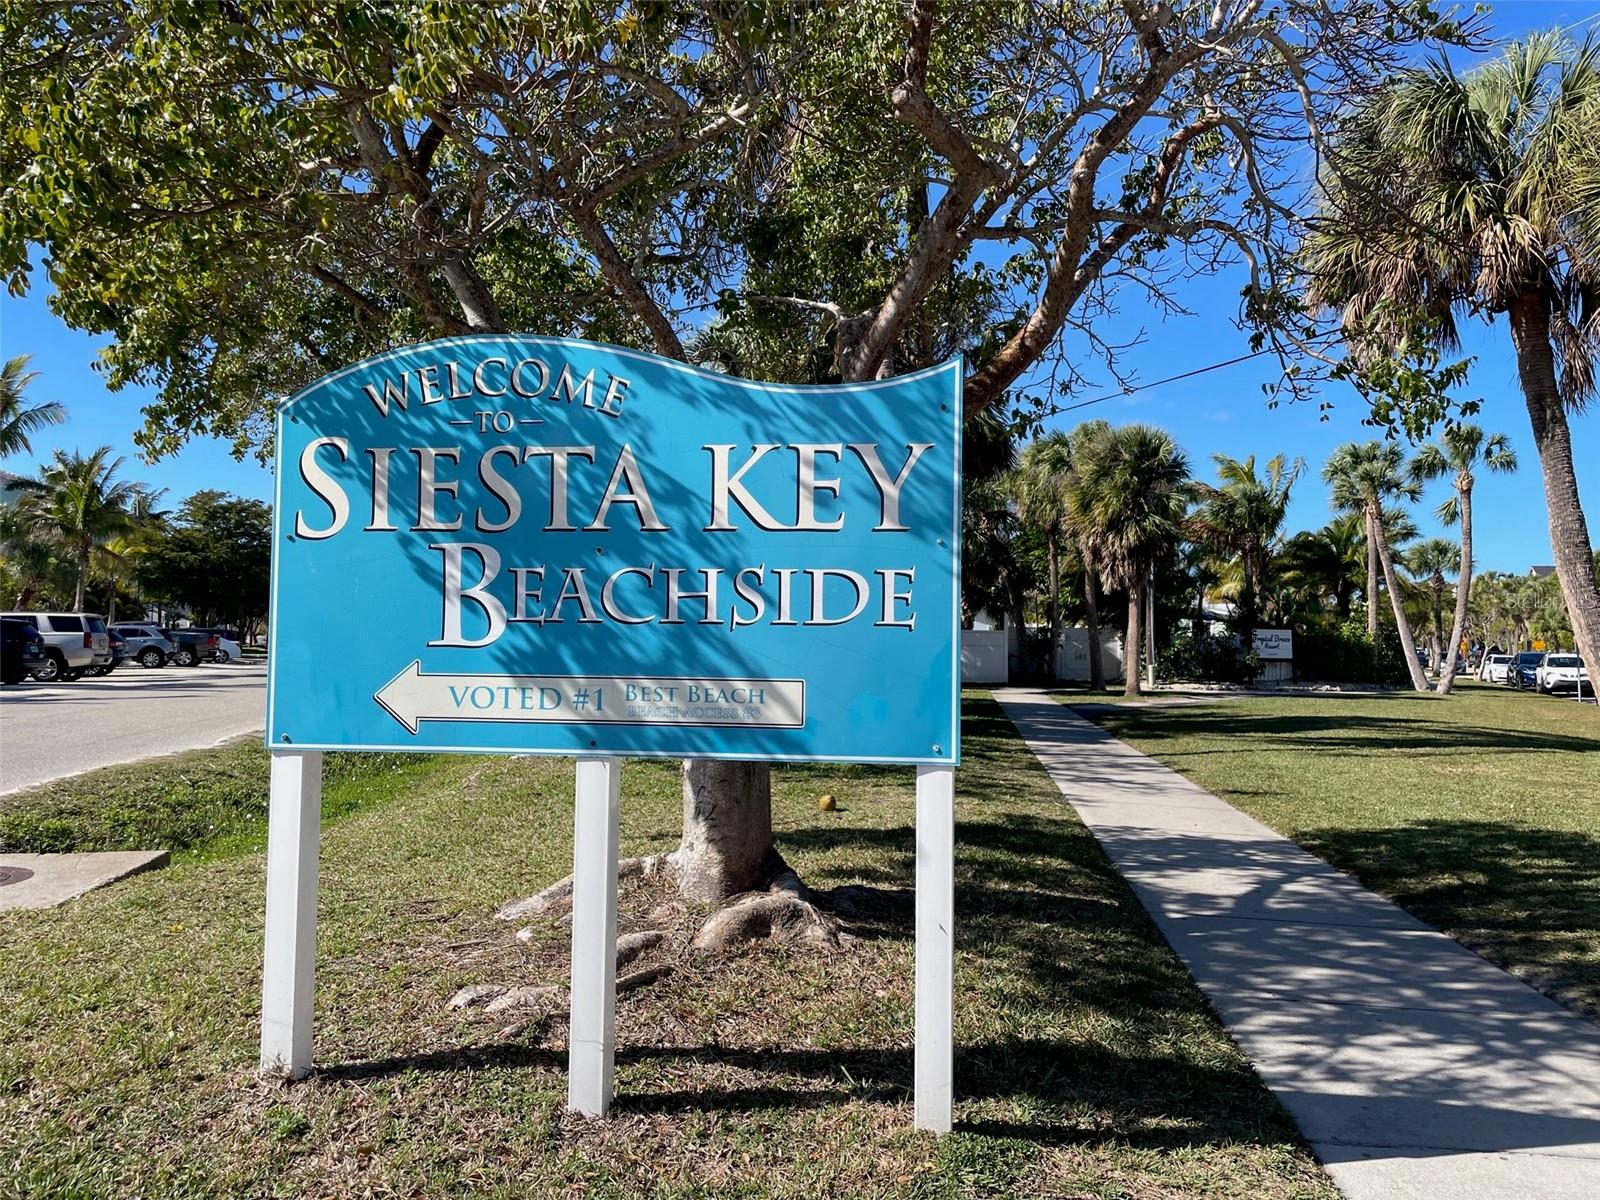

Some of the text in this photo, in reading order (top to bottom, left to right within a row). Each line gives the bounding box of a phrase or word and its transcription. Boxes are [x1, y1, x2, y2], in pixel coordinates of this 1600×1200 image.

[362, 357, 631, 418] WELCOME
[476, 411, 514, 433] TO
[295, 436, 936, 540] SIESTA KEY
[427, 542, 916, 648] BEACHSIDE
[448, 684, 765, 711] VOTED #1 BEST BEACH
[627, 705, 678, 718] BEACH
[682, 706, 739, 720] ACCESS
